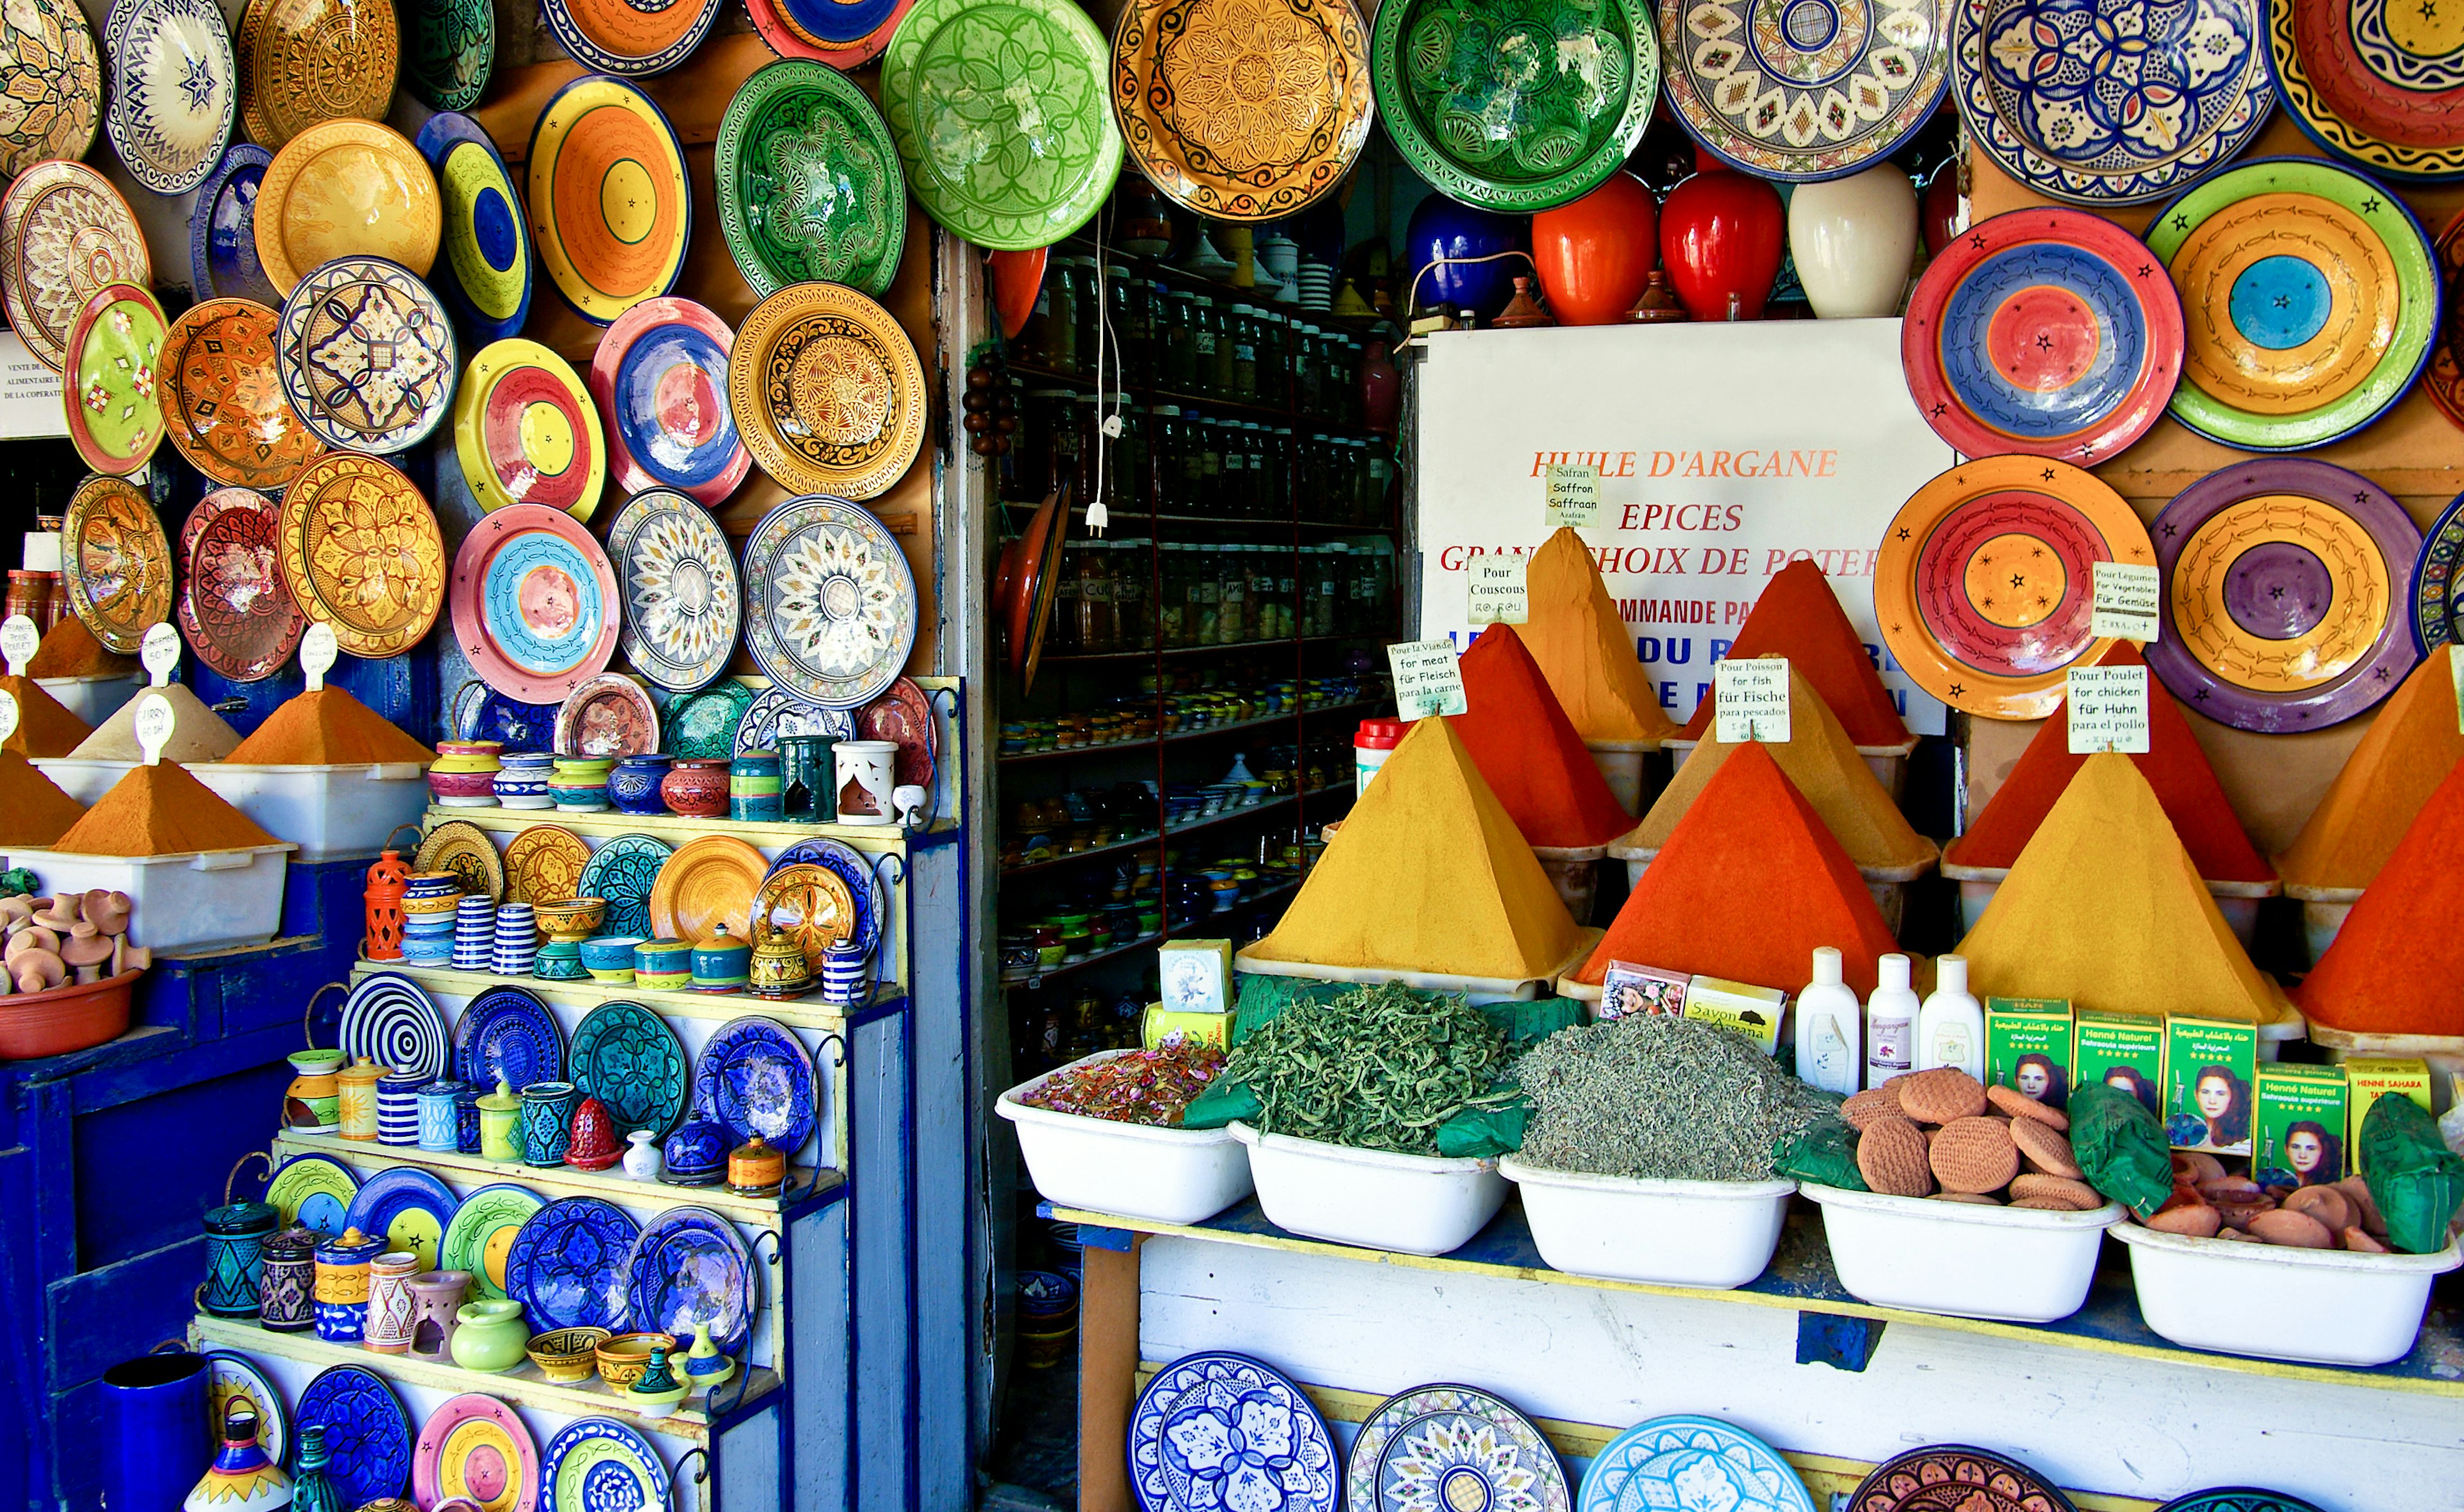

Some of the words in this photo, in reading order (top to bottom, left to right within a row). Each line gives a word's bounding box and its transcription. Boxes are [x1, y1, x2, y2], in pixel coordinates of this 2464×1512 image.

[7, 377, 54, 385] ALIMENTAIRE
[1647, 450, 1838, 478] D'ARGANE
[1557, 468, 1589, 477] Safran
[1553, 483, 1593, 493] Saffron
[1548, 498, 1597, 509] Saffraan
[1618, 504, 1743, 531] EPICES
[1587, 547, 1690, 575] HOIX
[1698, 548, 1749, 575] DE
[1484, 568, 1512, 578] Pour
[2096, 570, 2116, 579] Pour
[1471, 584, 1525, 595] Couscous
[2113, 582, 2156, 594] Vegetables
[2096, 593, 2114, 604] Für
[2118, 595, 2155, 608] Gemüse
[1391, 646, 1410, 655] Pour
[1421, 641, 1452, 652] Viande
[1638, 636, 1691, 665] DU
[1400, 659, 1417, 669] for
[1422, 656, 1448, 667] meat
[1721, 663, 1742, 672] Pour
[1746, 663, 1782, 671] Poisson
[1399, 675, 1416, 684] für
[1419, 669, 1455, 682] Fleisch
[1733, 677, 1747, 686] for
[1753, 676, 1771, 685] fish
[2071, 671, 2100, 681] Pour
[2104, 670, 2143, 680] Poulet
[1399, 689, 1420, 701] para
[1423, 686, 1432, 695] la
[1435, 684, 1461, 693] carne
[1719, 692, 1739, 702] für
[1743, 691, 1785, 702] Fische
[2075, 687, 2092, 697] for
[2098, 686, 2140, 697] chicken
[1720, 709, 1740, 718] para
[1743, 708, 1786, 718] pescados
[2079, 704, 2099, 715] für
[2105, 703, 2137, 714] Huhn
[2073, 722, 2096, 733] para
[2100, 720, 2110, 729] el
[2115, 719, 2145, 732] pollo
[1691, 1001, 1736, 1021] Savon
[2085, 1029, 2116, 1040] Henné
[2118, 1032, 2152, 1042] Naturel
[2357, 1078, 2384, 1087] HENNÉ
[2388, 1080, 2422, 1088] SAHARA
[2266, 1083, 2298, 1093] Henné
[2300, 1085, 2336, 1096] Naturel
